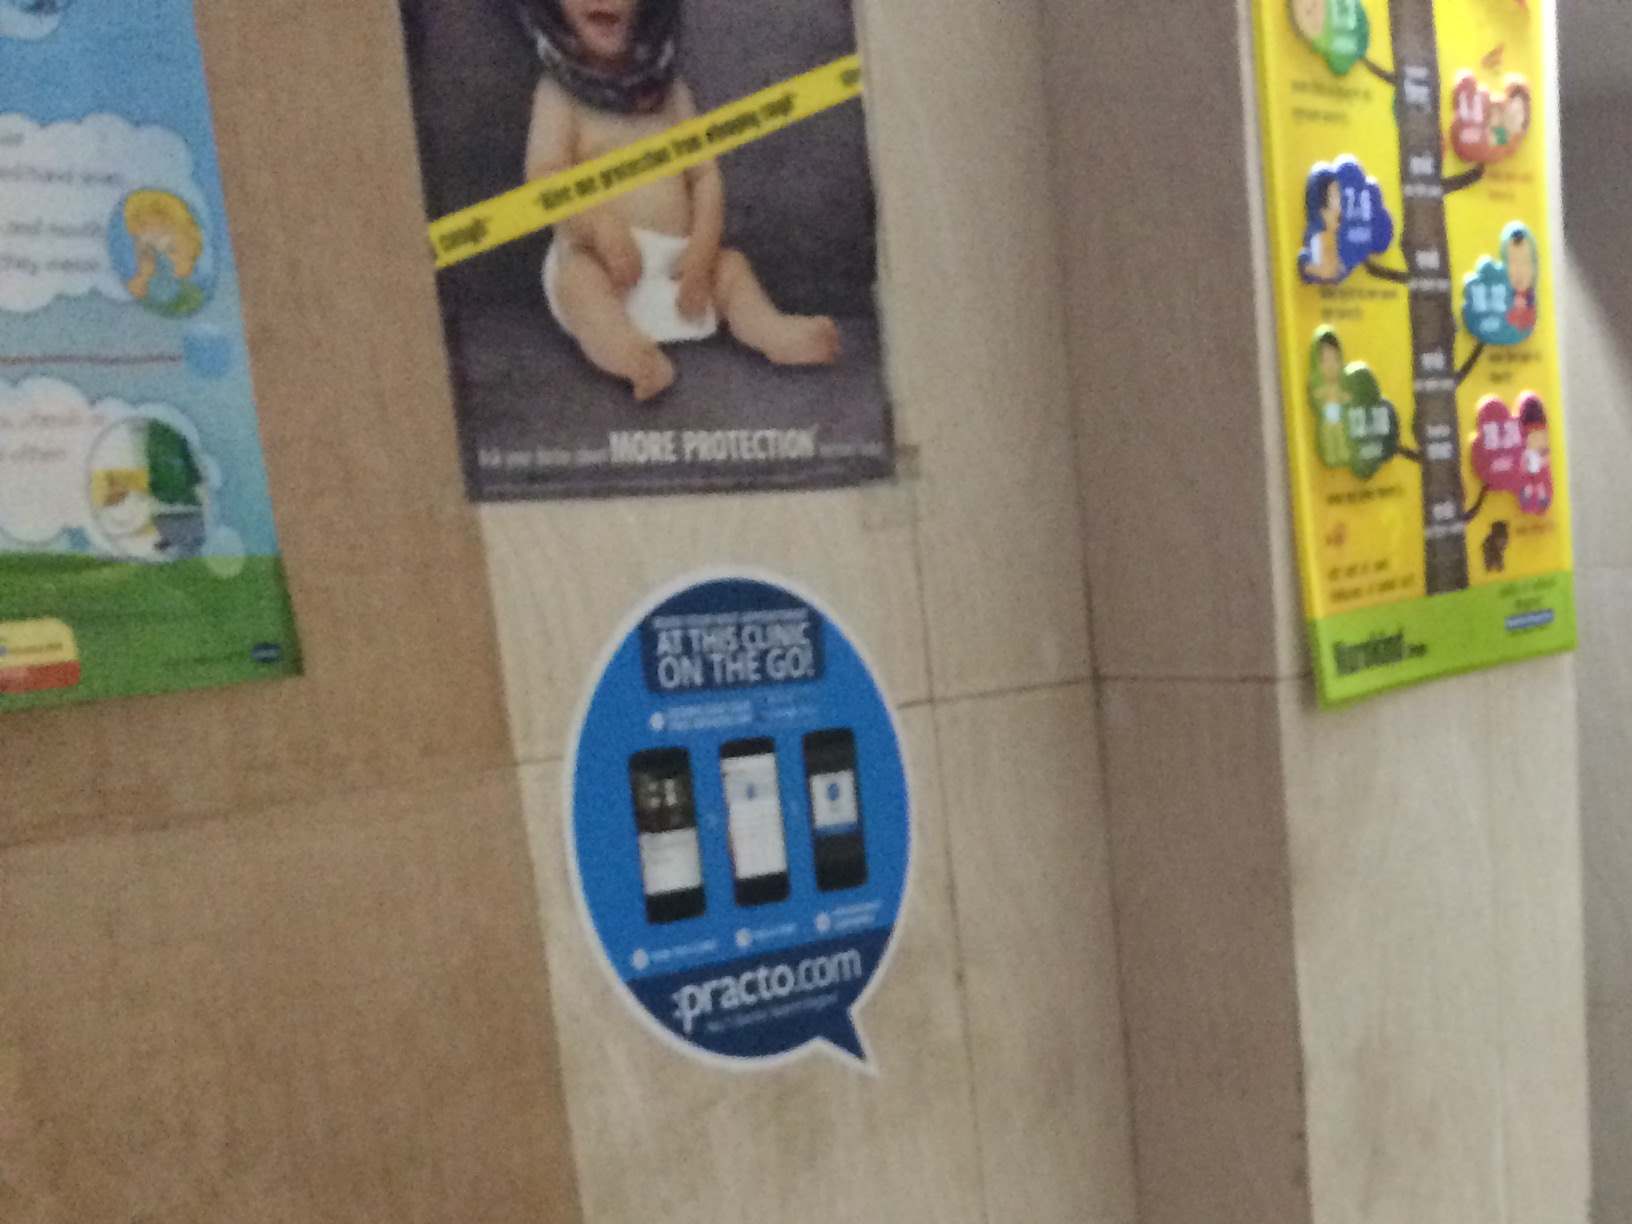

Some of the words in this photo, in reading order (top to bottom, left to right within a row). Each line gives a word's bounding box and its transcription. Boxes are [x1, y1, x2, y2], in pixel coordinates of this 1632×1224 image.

[609, 430, 676, 464] MORE
[682, 428, 817, 462] PROTECTION
[689, 623, 740, 653] THIS
[657, 655, 704, 689] ON
[711, 650, 762, 686] THE
[766, 645, 816, 681] GO!
[674, 947, 863, 1035] practo.com
